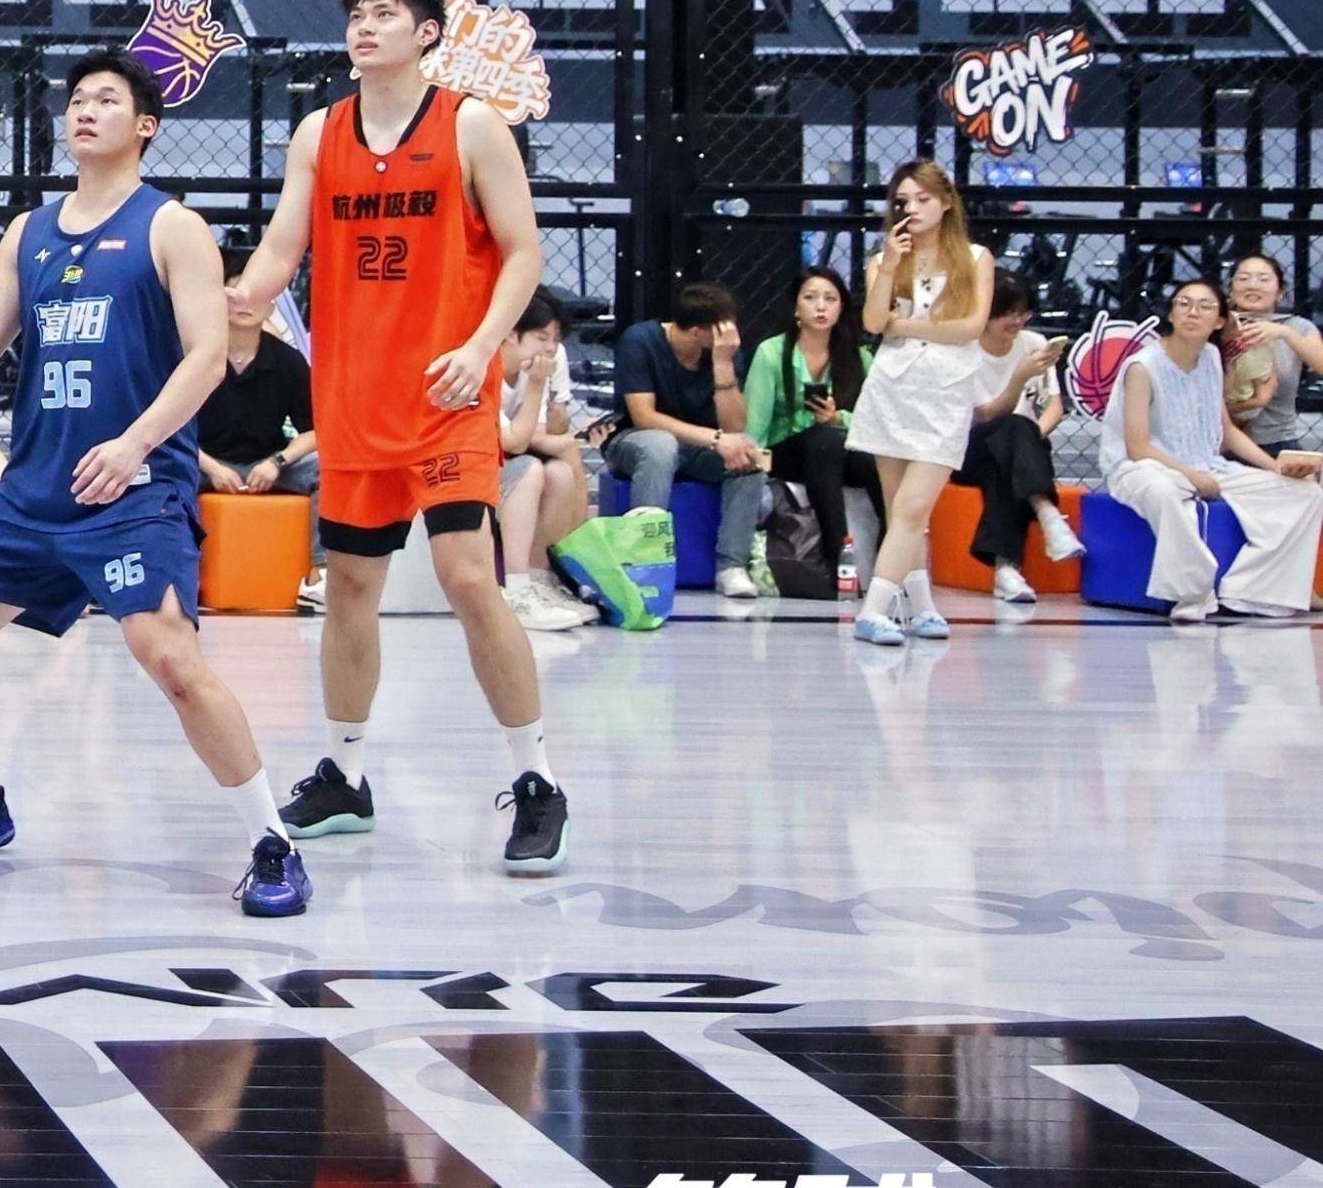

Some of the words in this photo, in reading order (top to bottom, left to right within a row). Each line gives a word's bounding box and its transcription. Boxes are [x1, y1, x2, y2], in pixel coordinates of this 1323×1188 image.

[955, 28, 1092, 116] GAME
[991, 75, 1073, 150] ON
[357, 235, 408, 281] 22
[38, 298, 111, 344] 富阳
[40, 360, 92, 409] 96
[421, 452, 461, 488] 22
[104, 551, 146, 594] 96
